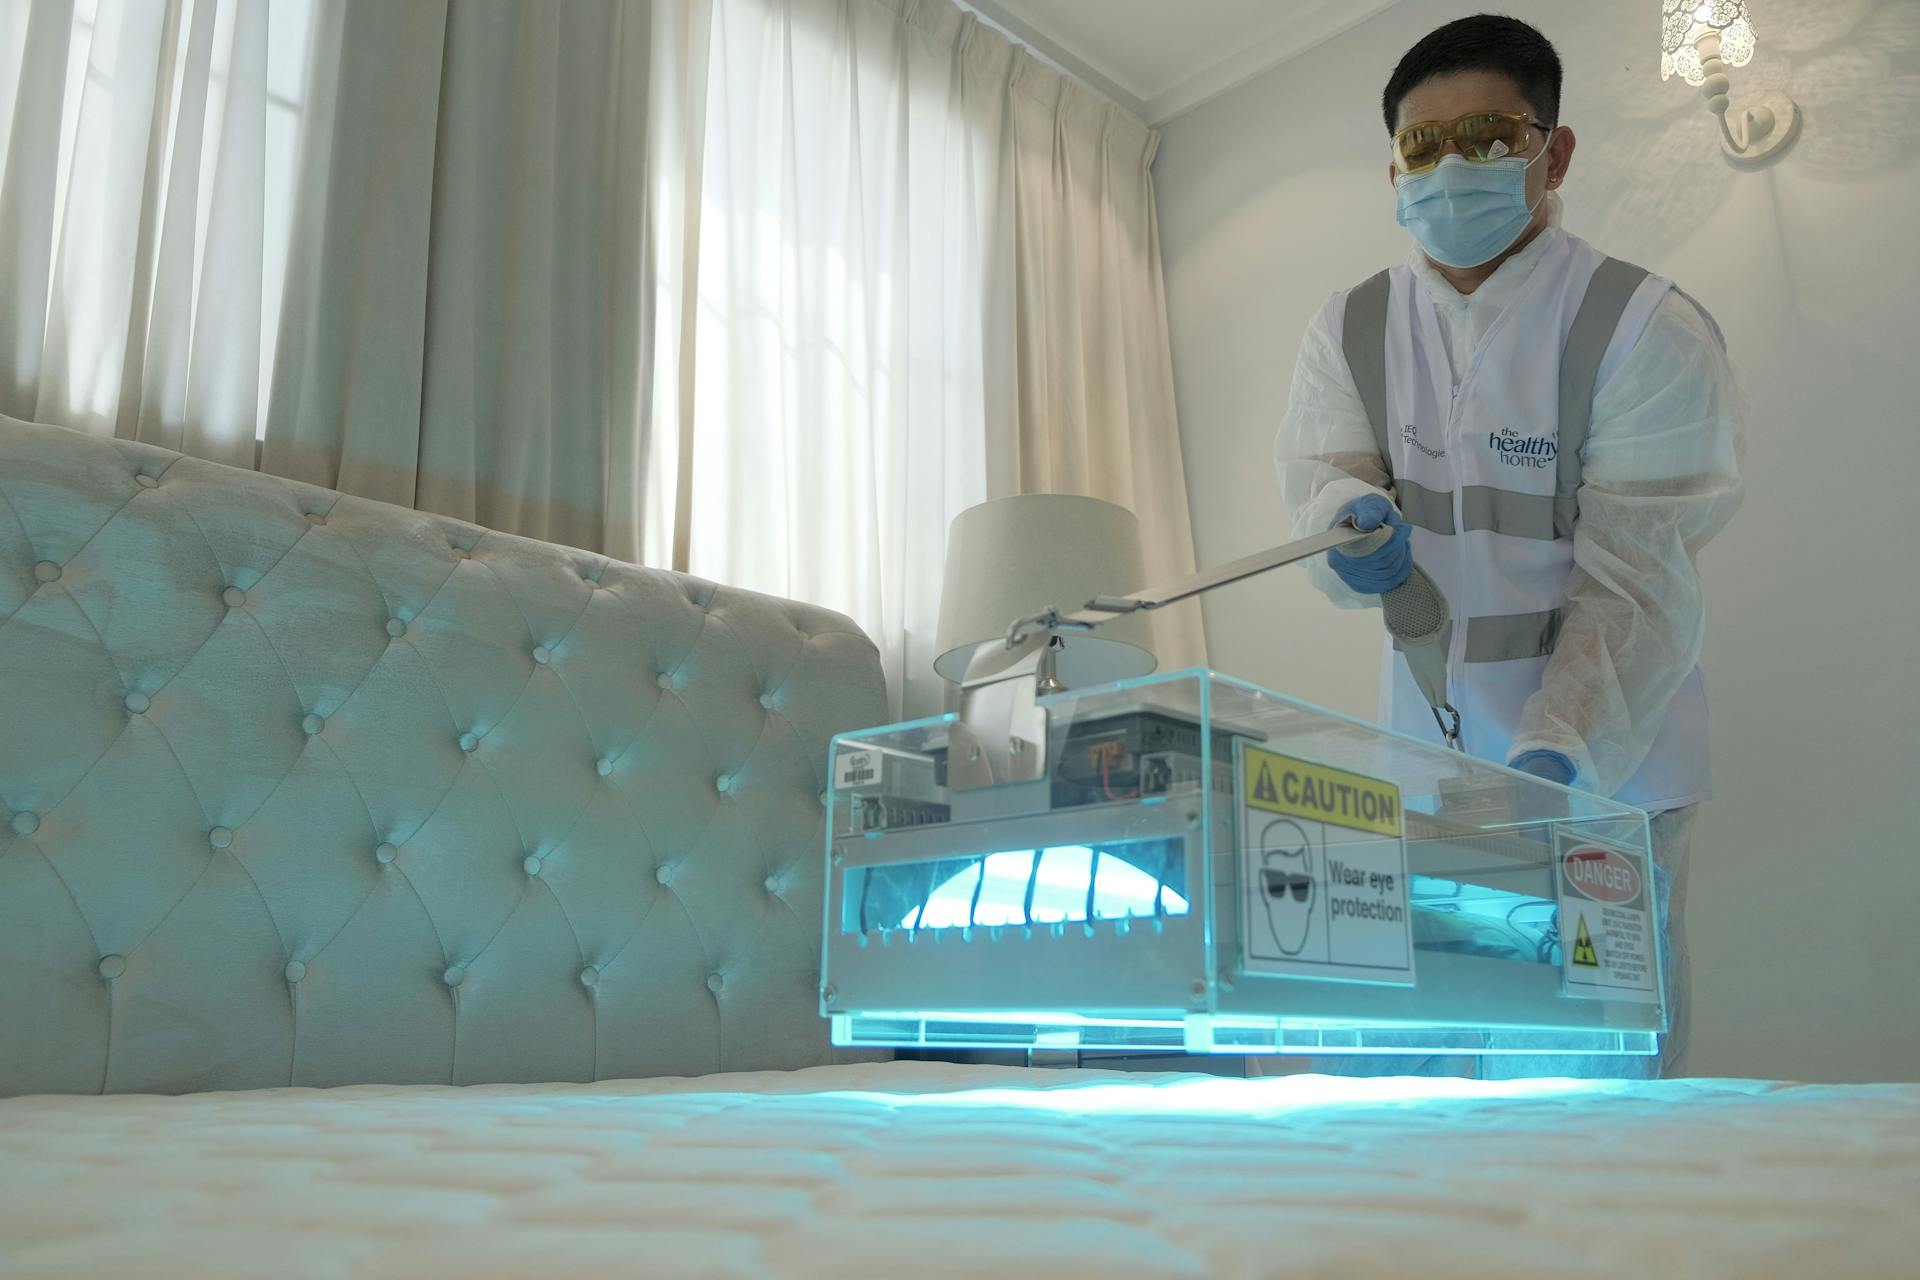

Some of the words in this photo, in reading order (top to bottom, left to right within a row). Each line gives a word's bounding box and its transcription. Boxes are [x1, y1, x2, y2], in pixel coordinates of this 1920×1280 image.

[1489, 432, 1557, 462] healthy
[1501, 427, 1519, 438] the
[1500, 450, 1547, 469] home
[1282, 769, 1396, 826] CAUTION
[1328, 859, 1366, 887] Wear
[1369, 871, 1394, 896] eye
[1573, 856, 1632, 893] DANGER
[1331, 896, 1403, 923] protection
